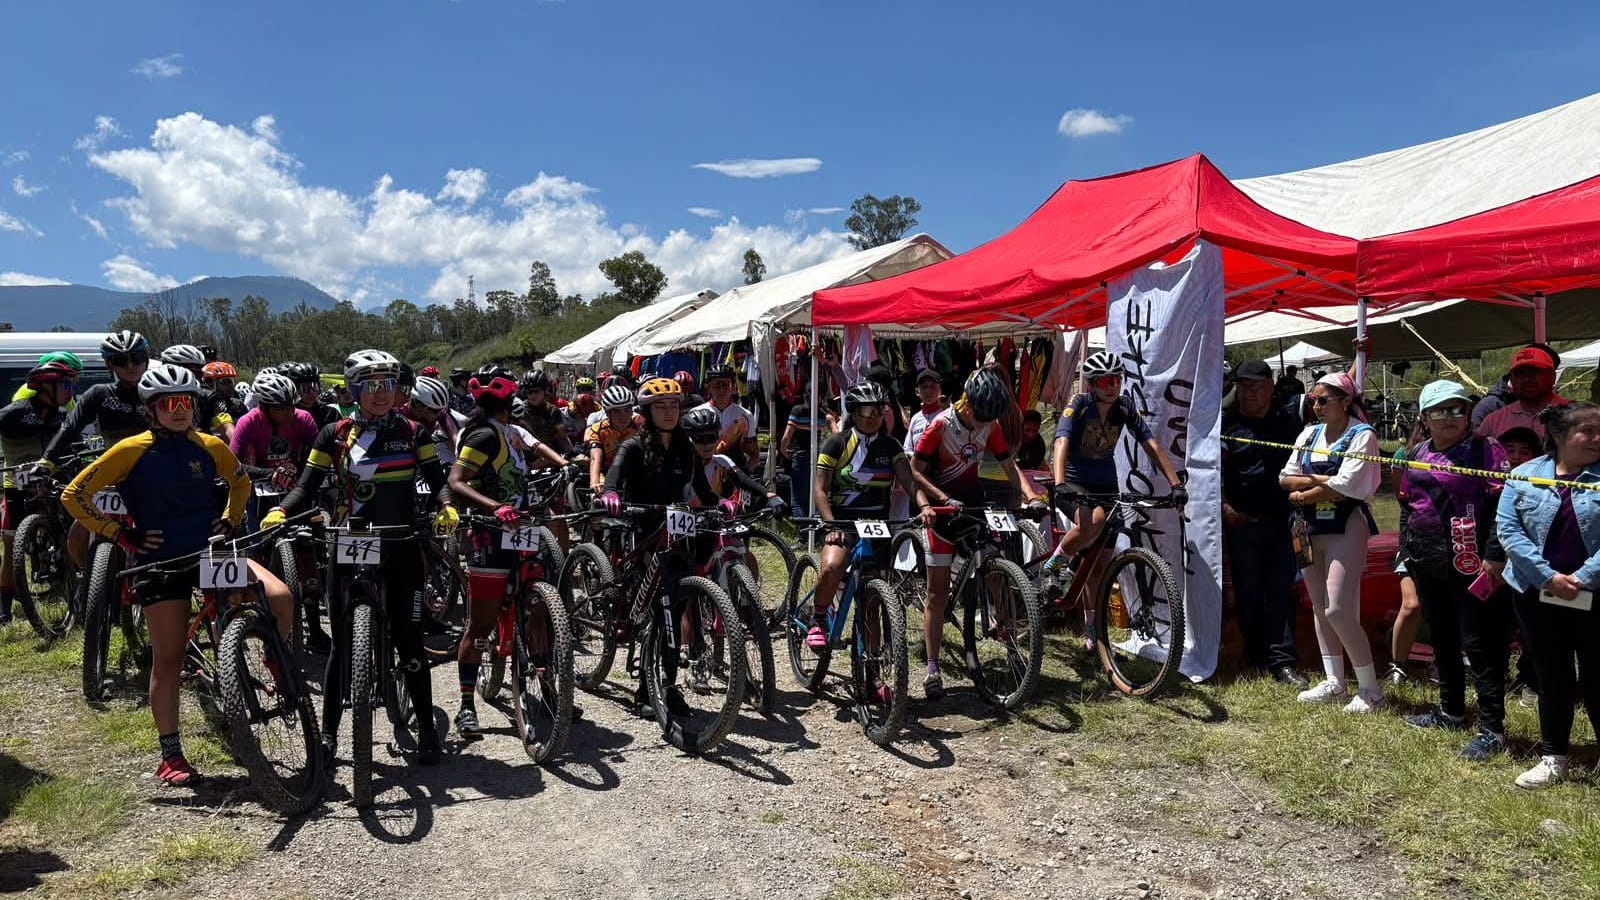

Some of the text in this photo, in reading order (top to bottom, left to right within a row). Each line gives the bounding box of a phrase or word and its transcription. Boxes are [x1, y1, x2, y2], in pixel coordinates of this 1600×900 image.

[669, 512, 694, 534] 142
[863, 524, 884, 536] 45
[209, 561, 239, 585] 70
